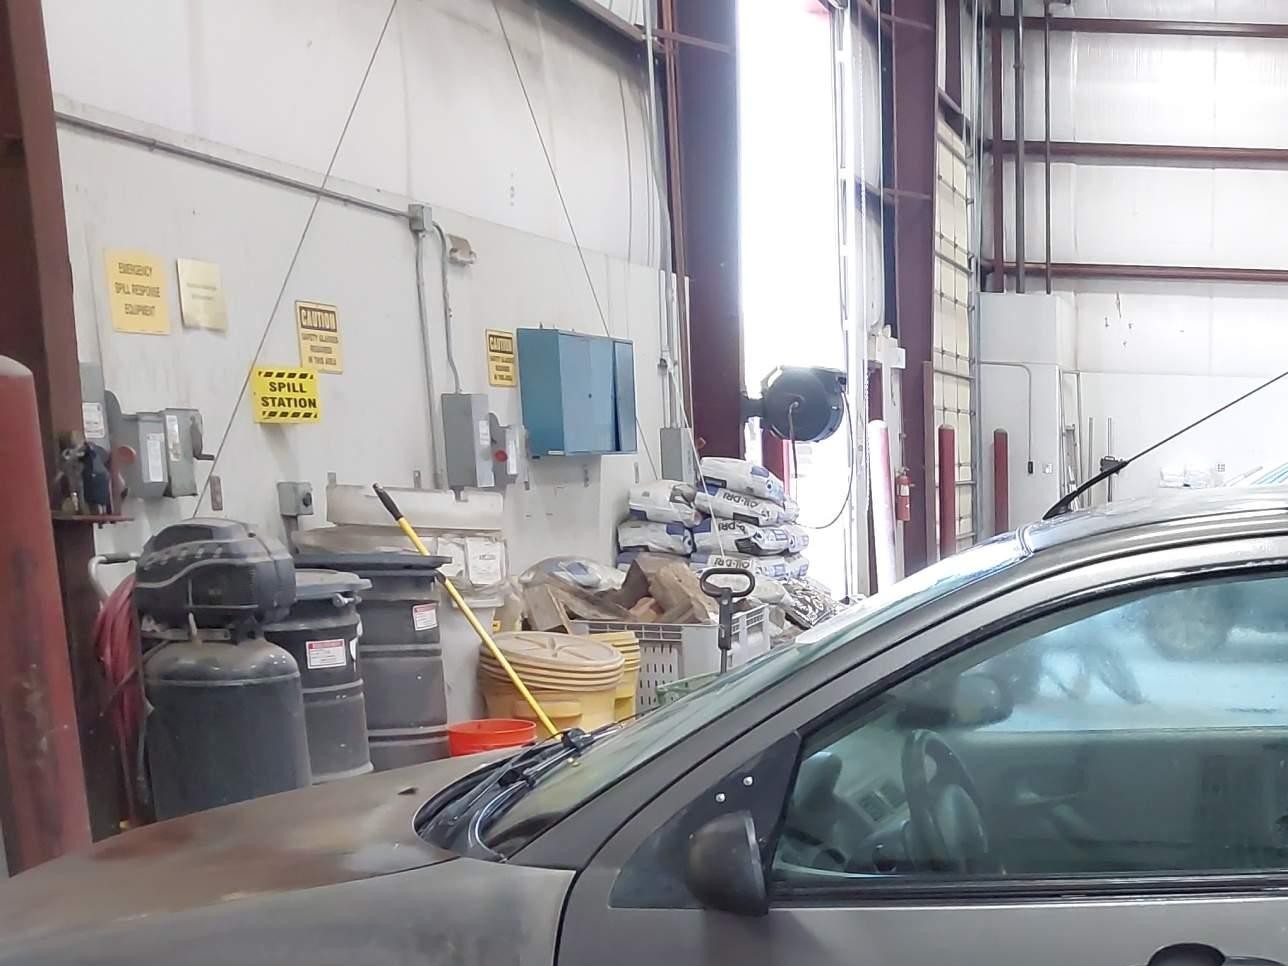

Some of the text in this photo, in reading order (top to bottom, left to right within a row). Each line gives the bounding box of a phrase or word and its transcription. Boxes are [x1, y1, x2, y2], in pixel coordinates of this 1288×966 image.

[300, 309, 337, 330] CAUTION
[268, 381, 307, 394] SPILL
[260, 396, 317, 409] STATION
